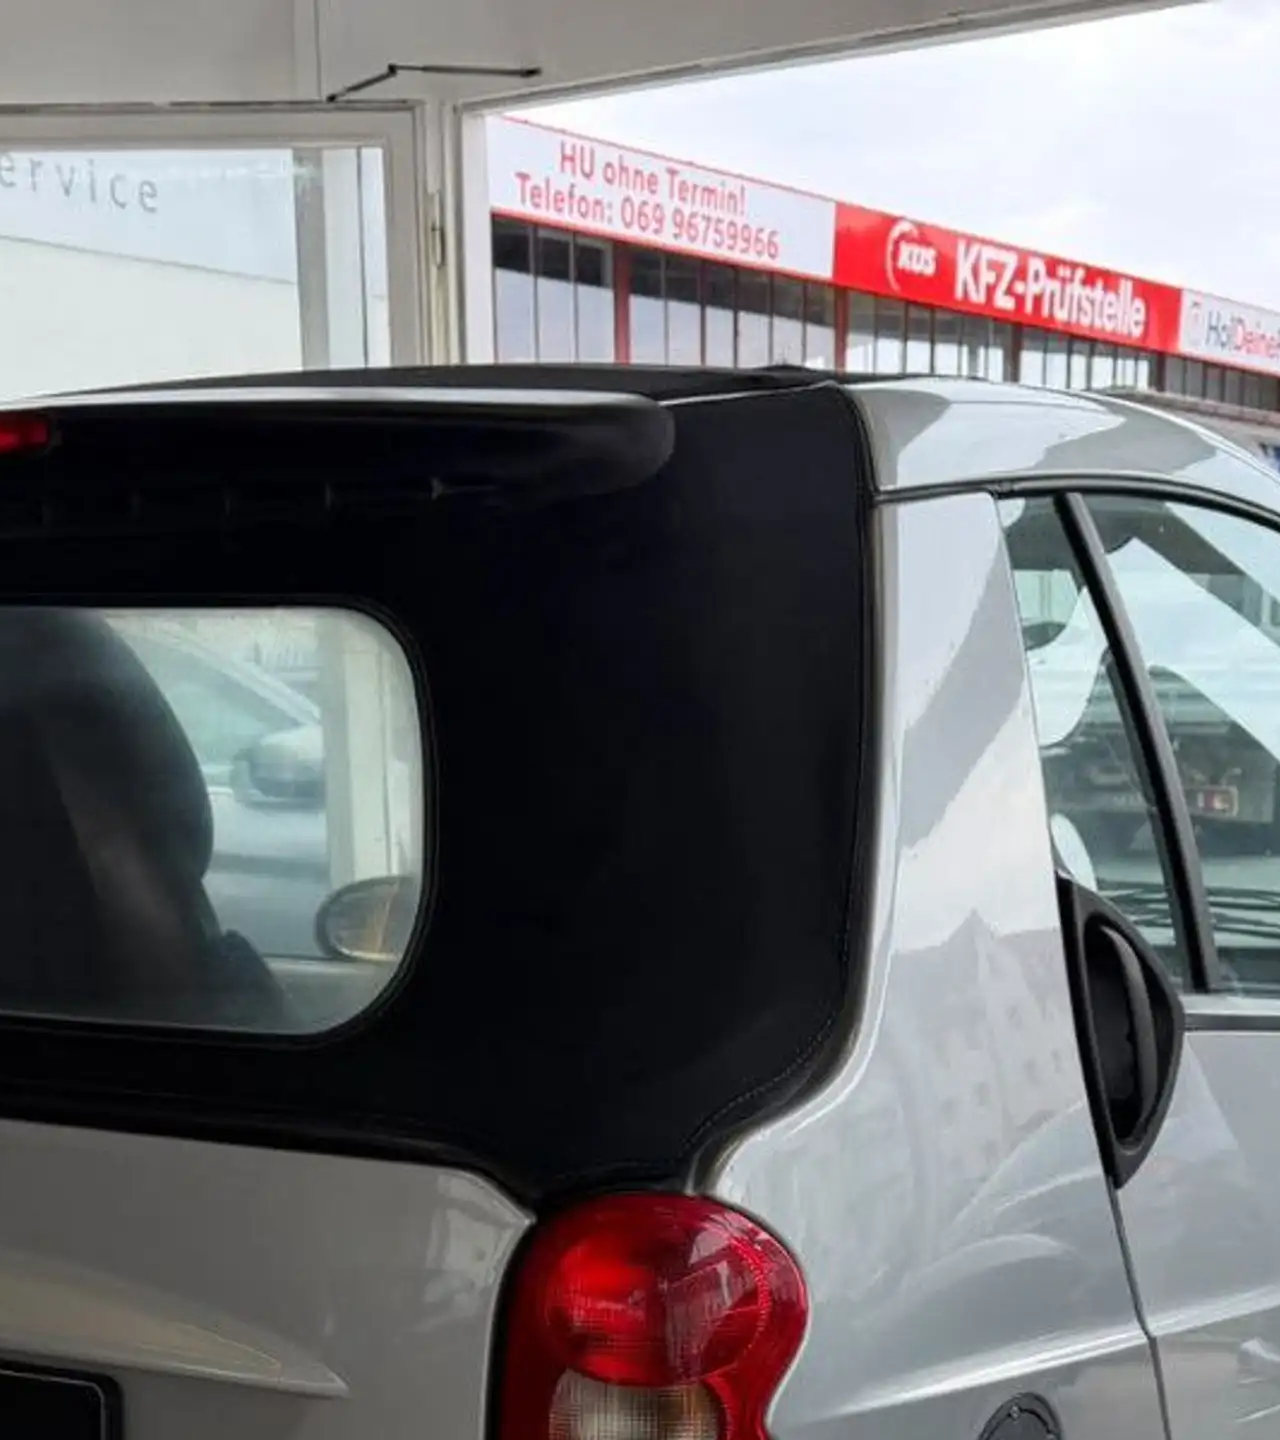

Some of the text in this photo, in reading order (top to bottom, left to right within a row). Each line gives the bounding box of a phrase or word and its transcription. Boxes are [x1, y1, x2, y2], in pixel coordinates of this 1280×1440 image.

[515, 172, 781, 260] Telefon: 069 96759966
[559, 141, 746, 215] HU ohne Termin!
[954, 239, 1147, 339] KFZ-Prüfstelle
